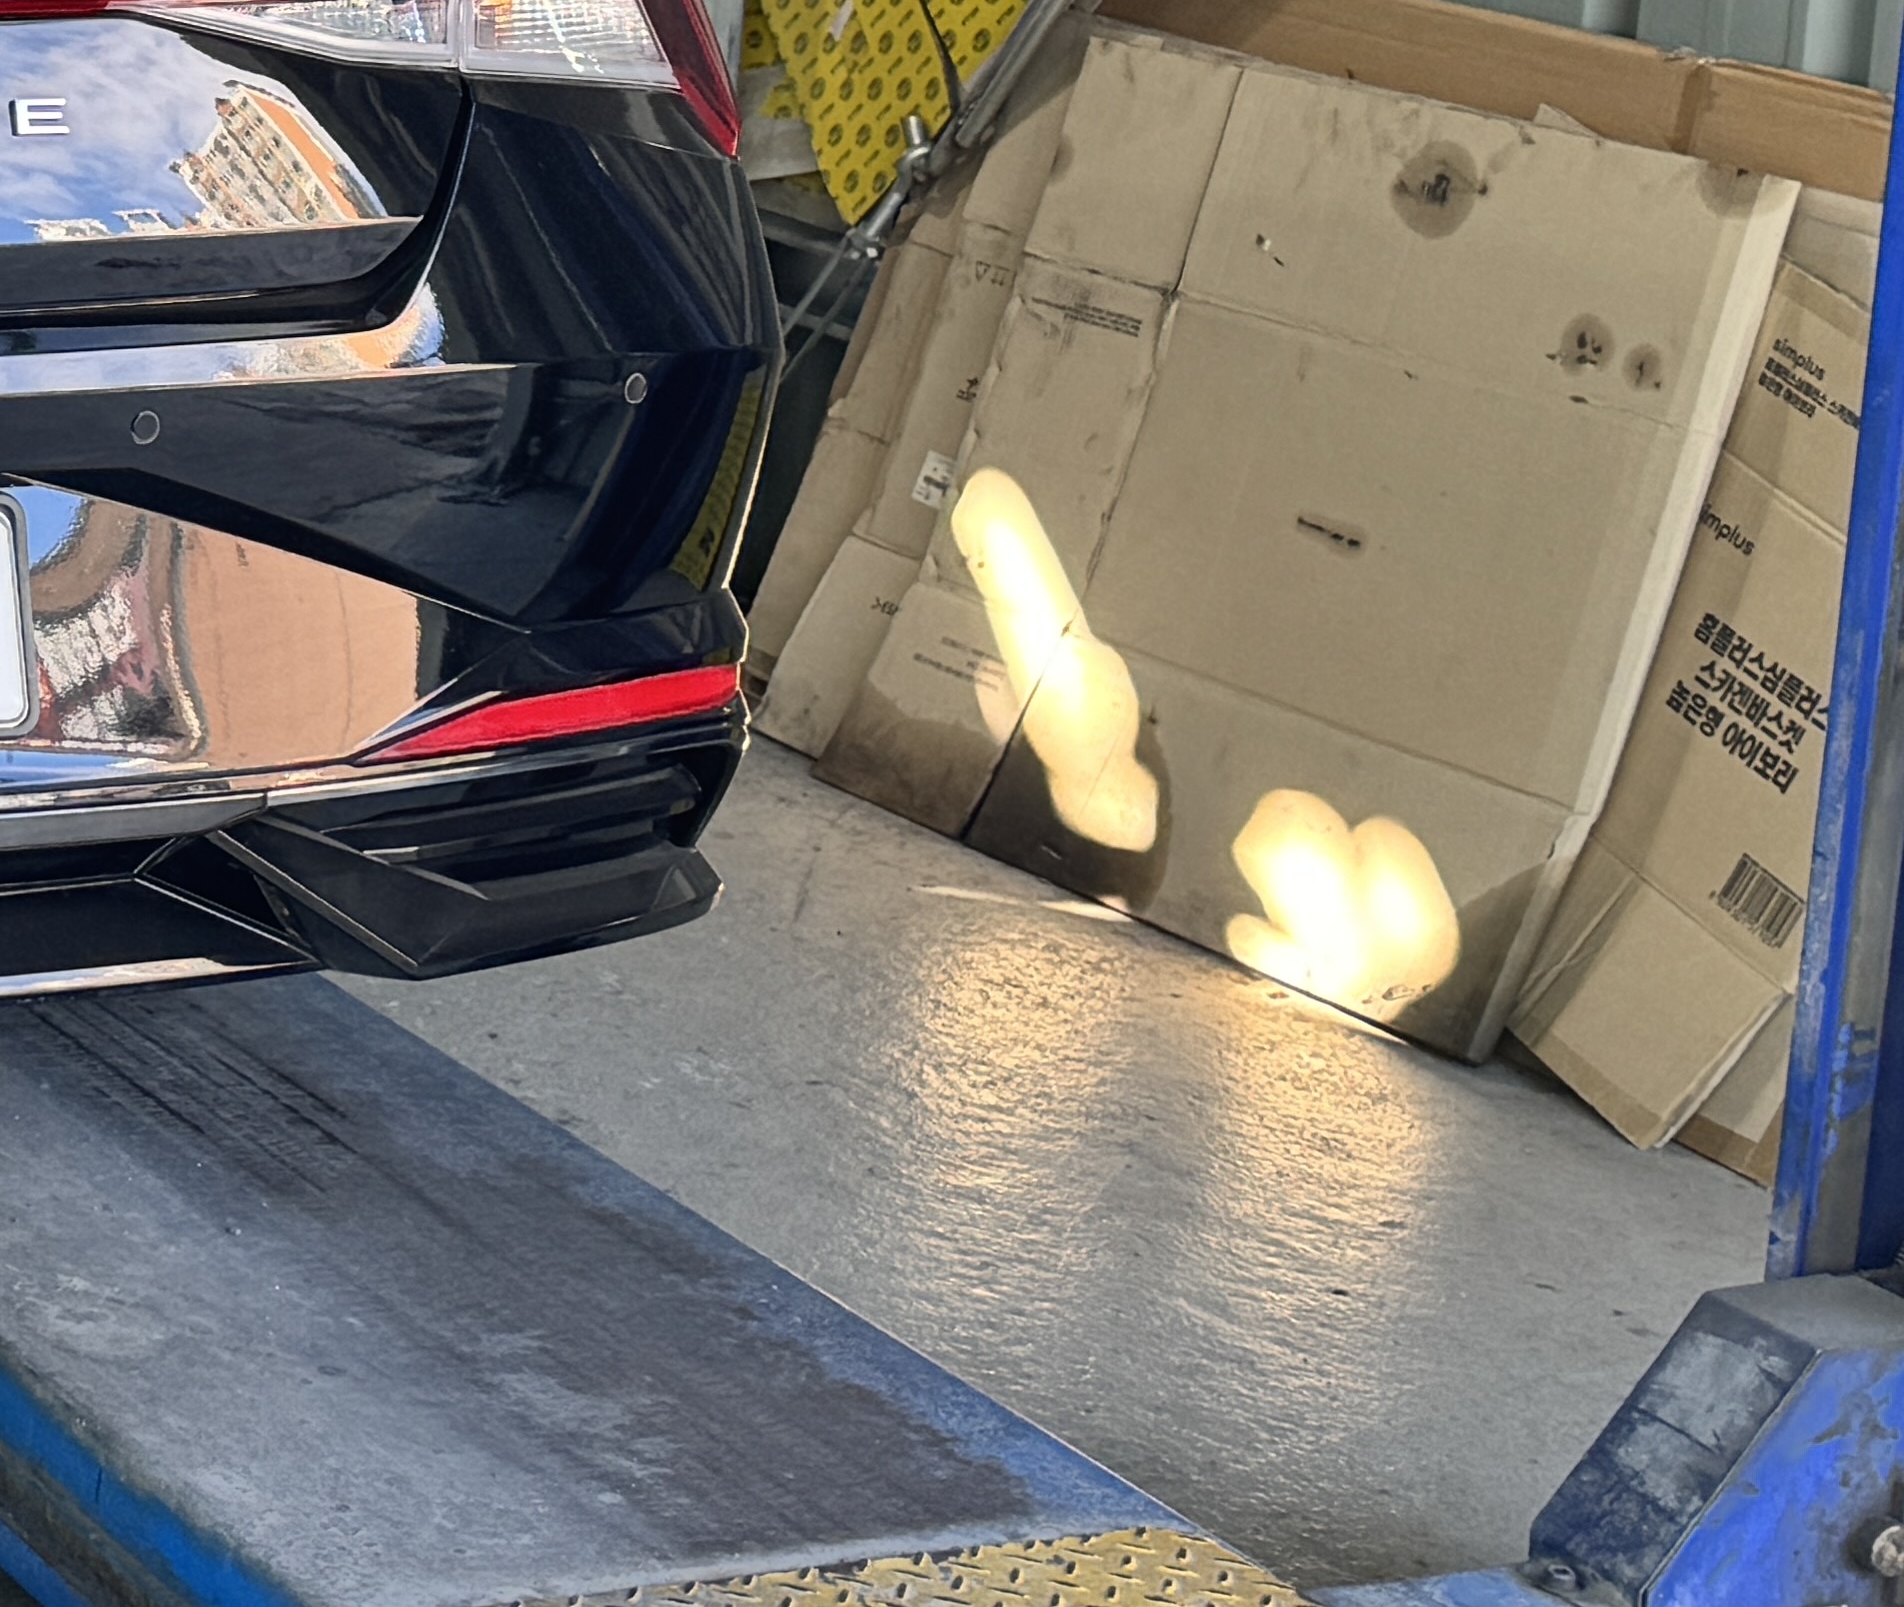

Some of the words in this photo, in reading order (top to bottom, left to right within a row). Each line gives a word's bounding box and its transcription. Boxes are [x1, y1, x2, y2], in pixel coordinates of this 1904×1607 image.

[1773, 338, 1826, 381] simplus
[1700, 502, 1755, 556] implus
[1694, 612, 1829, 732] 홈플러스심플러스
[1694, 660, 1807, 755] 스카겐바스켓
[1665, 679, 1726, 738] 높은형
[1721, 721, 1799, 795] 아이보리
